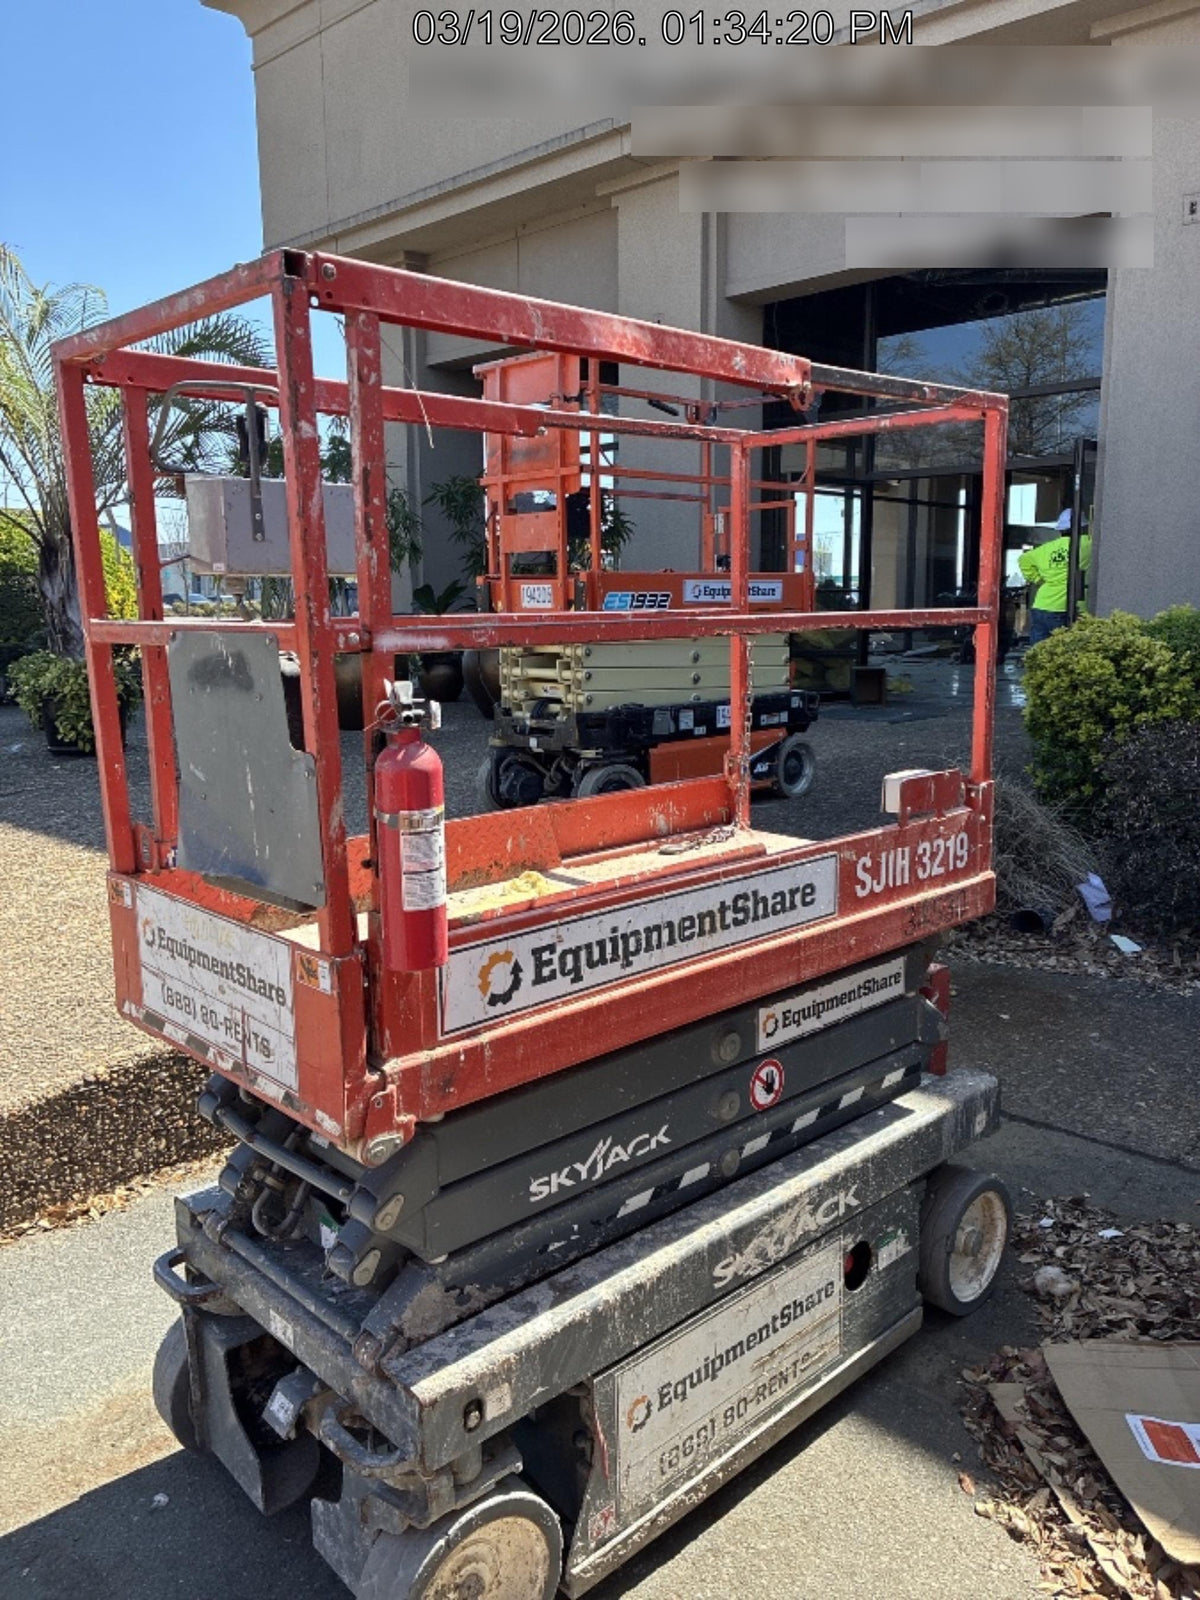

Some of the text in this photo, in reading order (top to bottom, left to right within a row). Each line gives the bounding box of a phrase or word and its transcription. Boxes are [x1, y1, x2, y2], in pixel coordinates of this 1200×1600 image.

[603, 592, 671, 610] ES1932
[916, 832, 968, 880] 3219
[157, 925, 287, 1007] EquipmentShare
[531, 882, 816, 987] EquipmentShare
[200, 1005, 274, 1059] 80-RENTS
[782, 971, 902, 1029] EquipmentShare
[529, 1124, 672, 1203] SKYJACK
[657, 1280, 835, 1412] EquipmentShare
